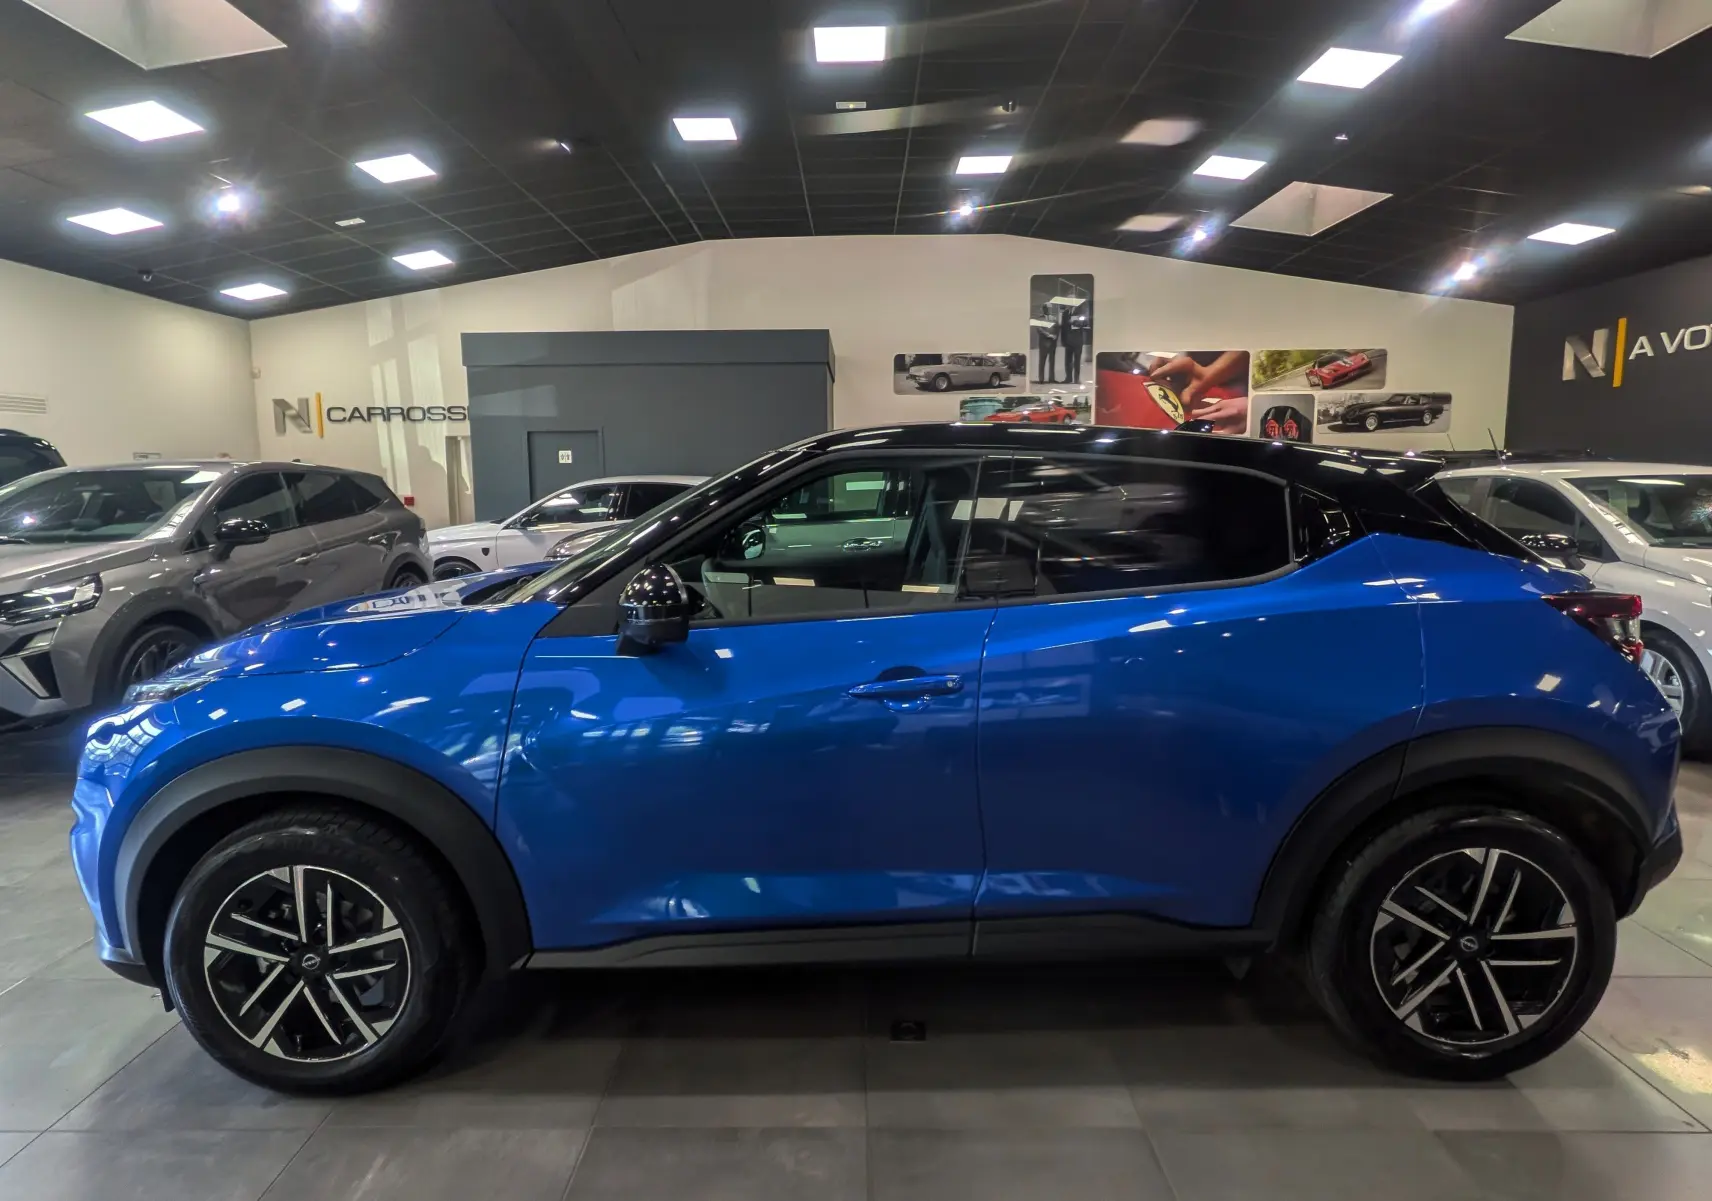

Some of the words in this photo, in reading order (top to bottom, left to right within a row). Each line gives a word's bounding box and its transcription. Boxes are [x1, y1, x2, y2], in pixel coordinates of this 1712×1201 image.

[1628, 335, 1655, 361] A
[1660, 323, 1712, 354] VO
[326, 405, 470, 423] CARROSS
